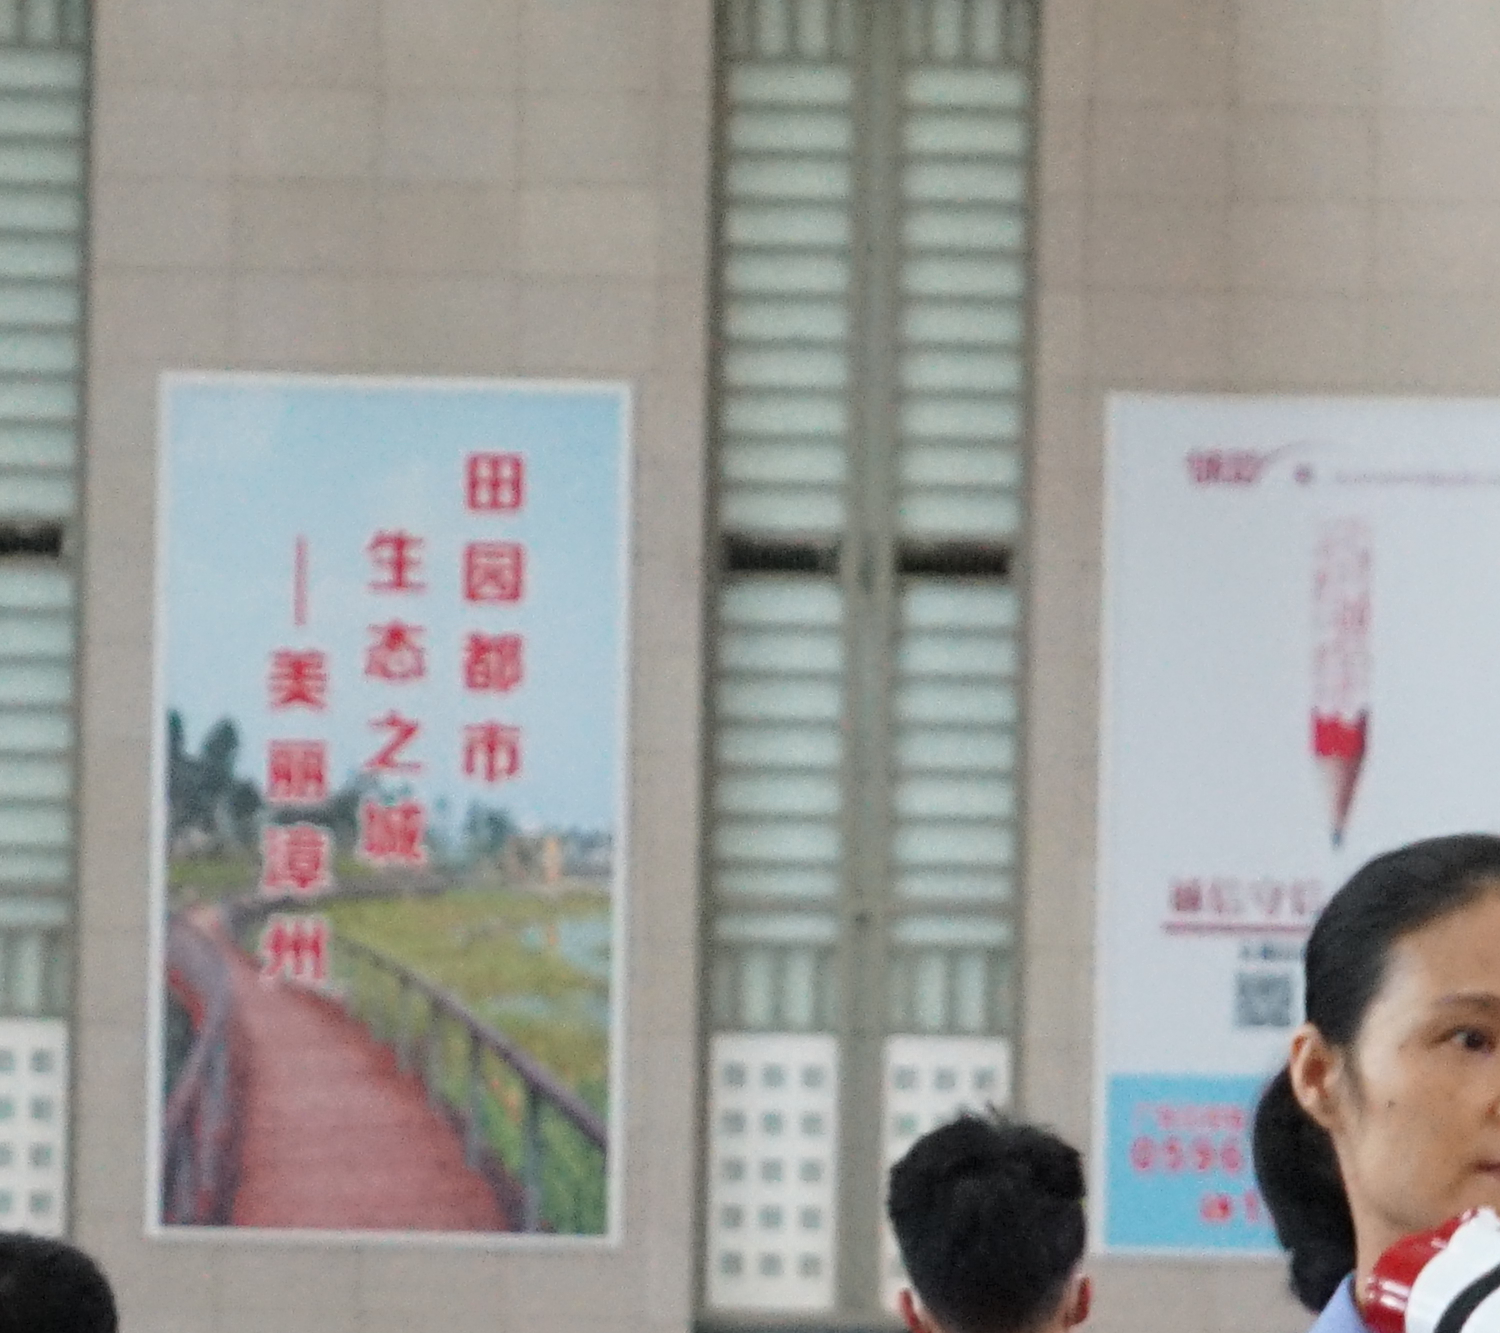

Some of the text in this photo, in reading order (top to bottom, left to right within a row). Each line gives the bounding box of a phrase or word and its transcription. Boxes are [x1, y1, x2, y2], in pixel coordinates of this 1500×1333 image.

[364, 529, 426, 863] 生态之城
[462, 451, 526, 782] 田园都市
